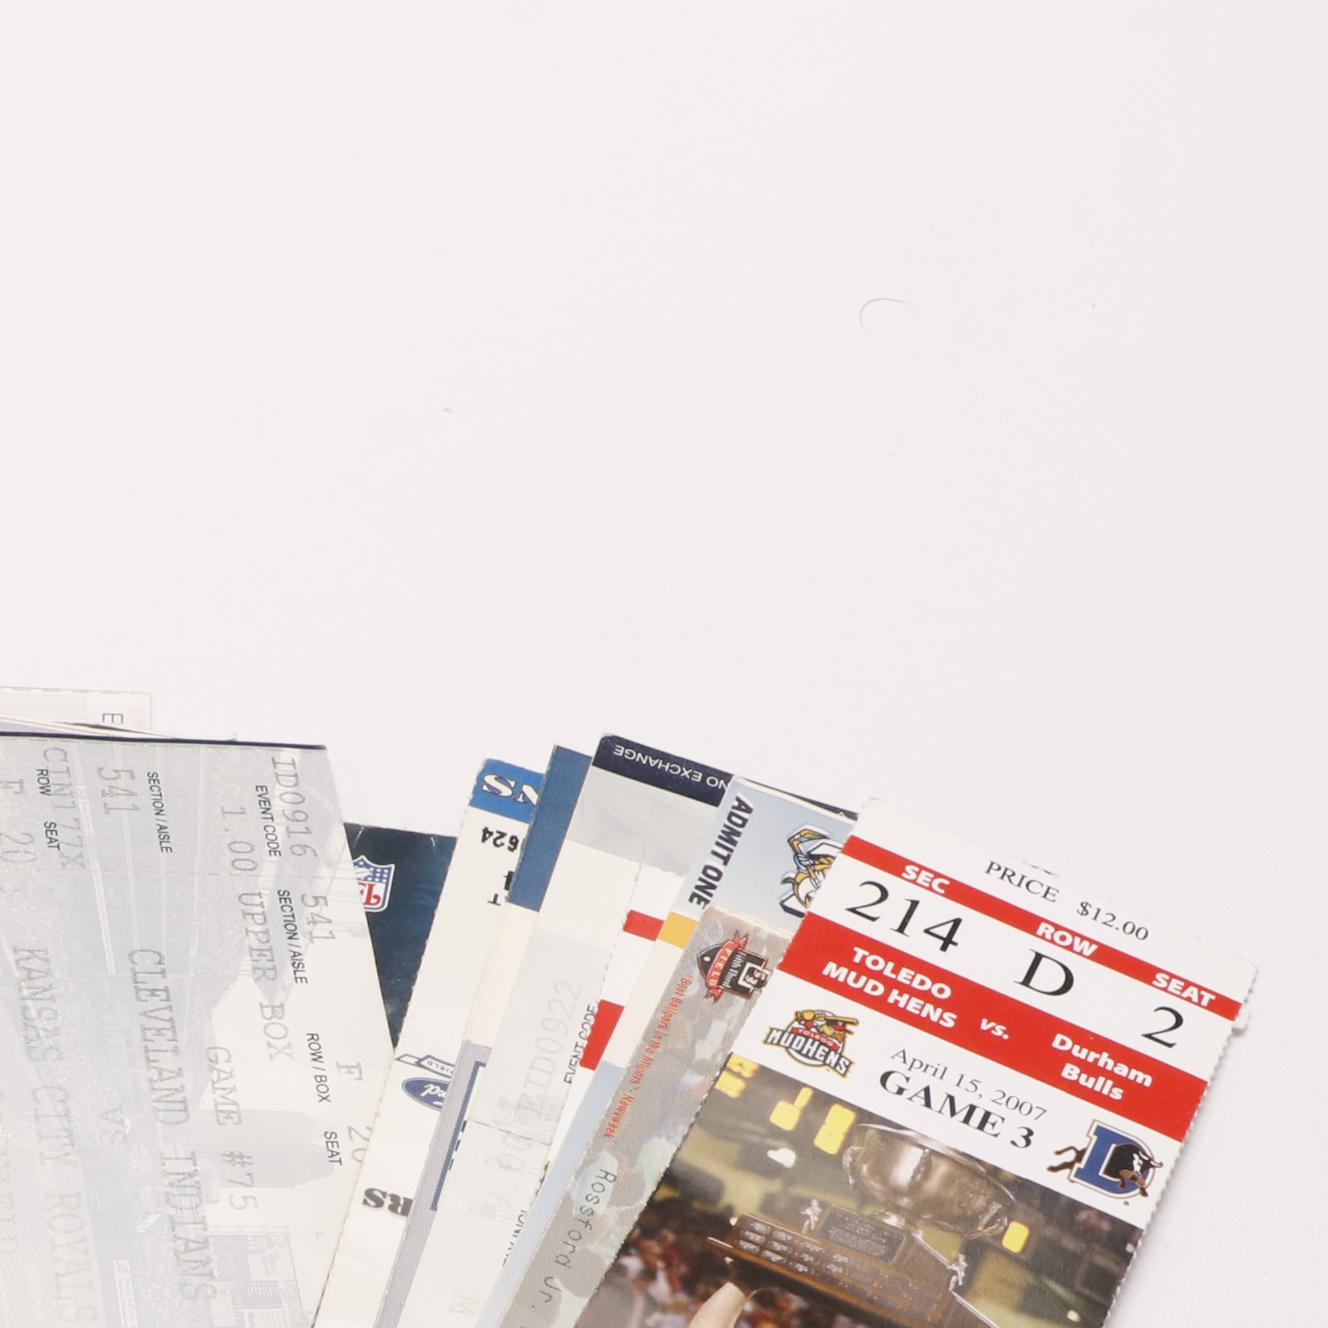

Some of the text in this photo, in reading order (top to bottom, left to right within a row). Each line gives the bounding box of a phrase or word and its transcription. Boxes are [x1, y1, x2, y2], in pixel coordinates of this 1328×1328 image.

[36, 768, 52, 797] ROW
[614, 744, 702, 782] EXCHANGE
[44, 820, 60, 850] SEAT
[147, 771, 173, 854] SECTION AISLE
[255, 784, 282, 857] EVENT CODE
[688, 796, 754, 910] ADMIT ONE
[277, 889, 308, 985] SECTION AISLE
[300, 893, 336, 945] 541
[901, 864, 1217, 1007] SEC ROW SEAT
[985, 858, 1151, 942] PRICE $12.00
[237, 891, 278, 982] UPPER
[259, 1002, 295, 1062] BOX
[845, 880, 1186, 1049] 214 D 2
[767, 1028, 852, 1076] MUDHENS
[821, 961, 1126, 1103] MUD HENS Bulls
[850, 945, 1154, 1088] TOLEDO vs. Durham
[205, 1046, 243, 1127] GAME
[305, 1032, 332, 1103] ROW BOX
[336, 1061, 364, 1082] F
[890, 1046, 1049, 1123] April 15, 2007
[127, 949, 218, 1300] CLEVELAND INDIANS
[324, 1130, 343, 1166] SEAT
[878, 1069, 1035, 1151] GAME 3
[555, 1167, 618, 1265] Rossford
